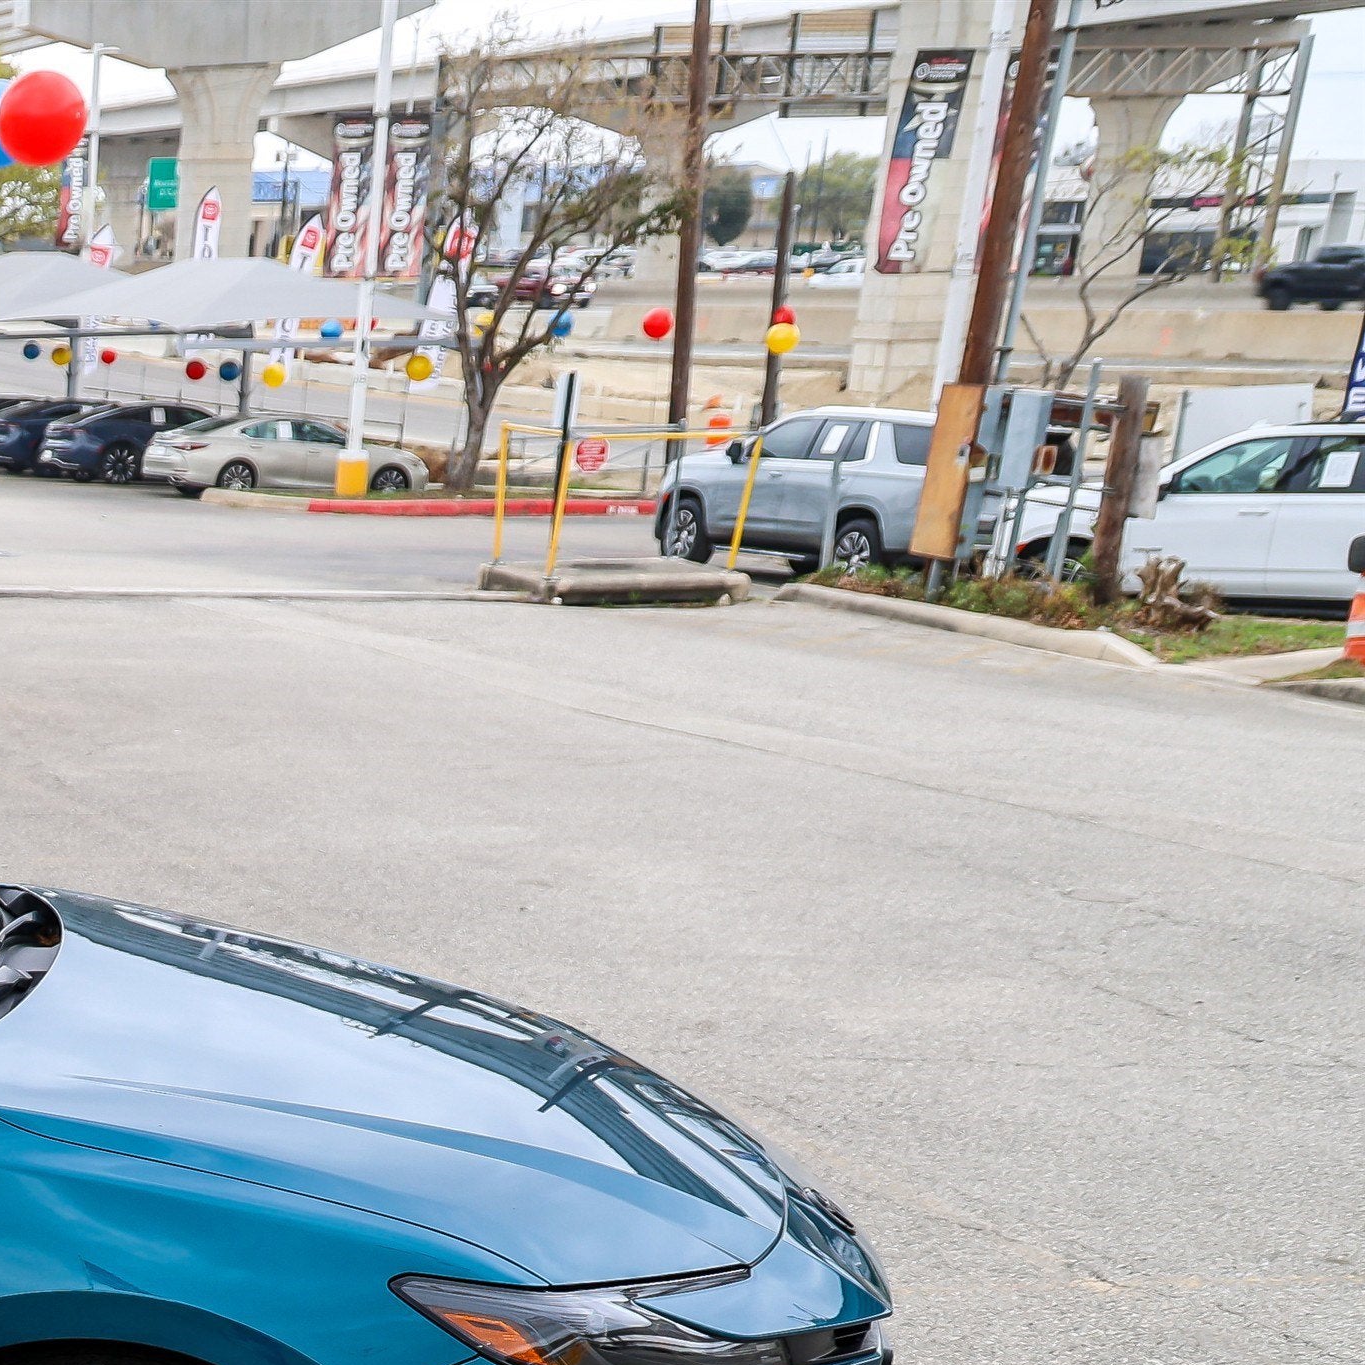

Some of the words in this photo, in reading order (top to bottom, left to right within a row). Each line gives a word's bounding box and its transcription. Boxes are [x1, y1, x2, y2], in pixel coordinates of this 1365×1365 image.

[899, 102, 949, 206] Owned
[67, 157, 84, 214] Owned
[336, 152, 362, 231] Owned
[391, 152, 417, 231] Owned
[62, 215, 81, 243] Pre
[330, 232, 355, 272] Pre
[385, 232, 409, 272] Pre
[887, 210, 922, 261] Pre
